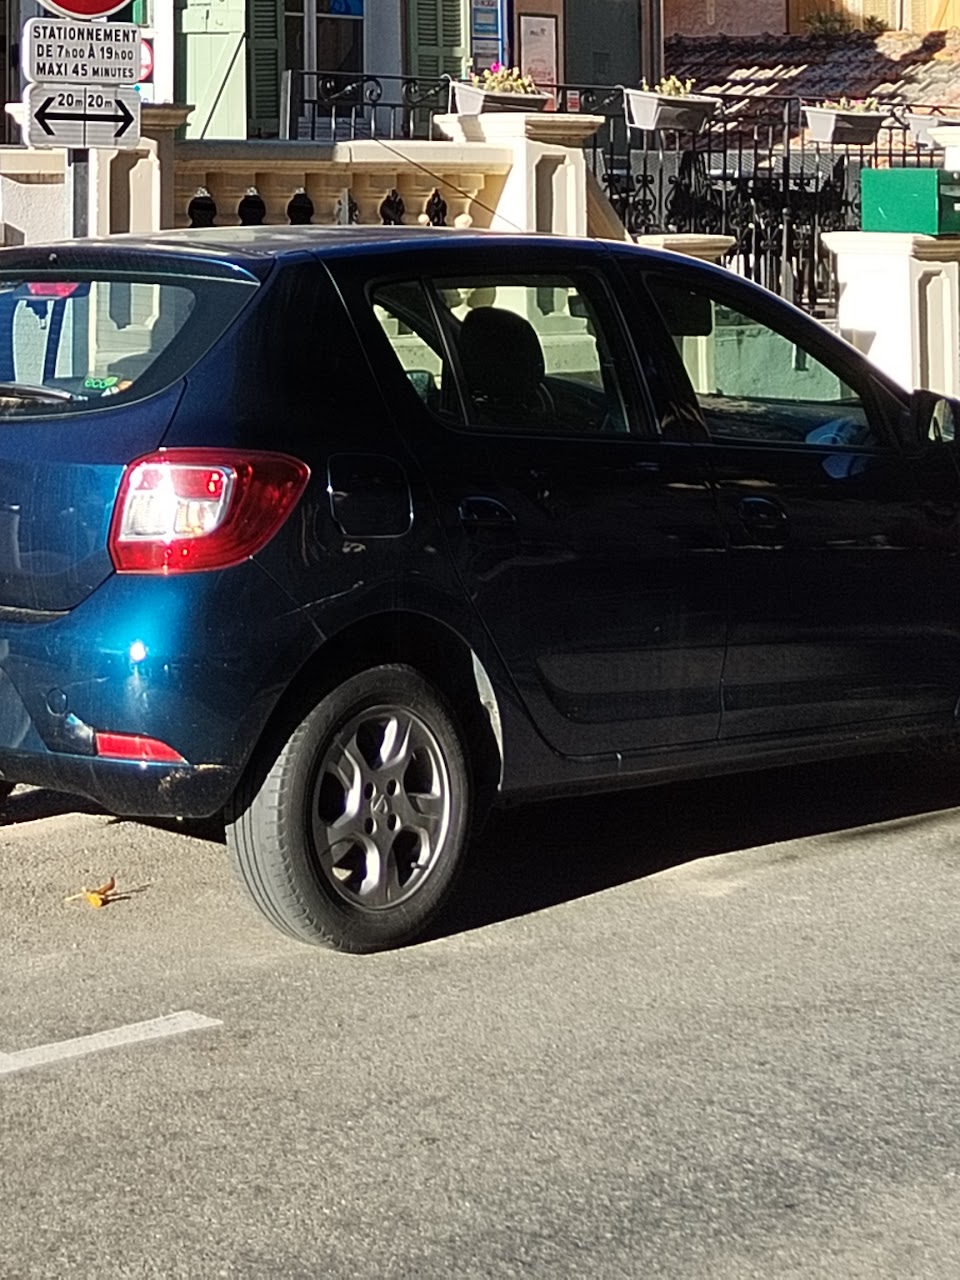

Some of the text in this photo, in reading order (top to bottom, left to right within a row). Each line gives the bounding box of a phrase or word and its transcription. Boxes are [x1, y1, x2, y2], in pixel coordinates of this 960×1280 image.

[33, 25, 138, 43] STATIONNEMENT
[36, 43, 134, 61] DE 7h00 À 19h00
[36, 62, 134, 78] MAXI 45 MINUTES
[84, 378, 106, 389] eco
